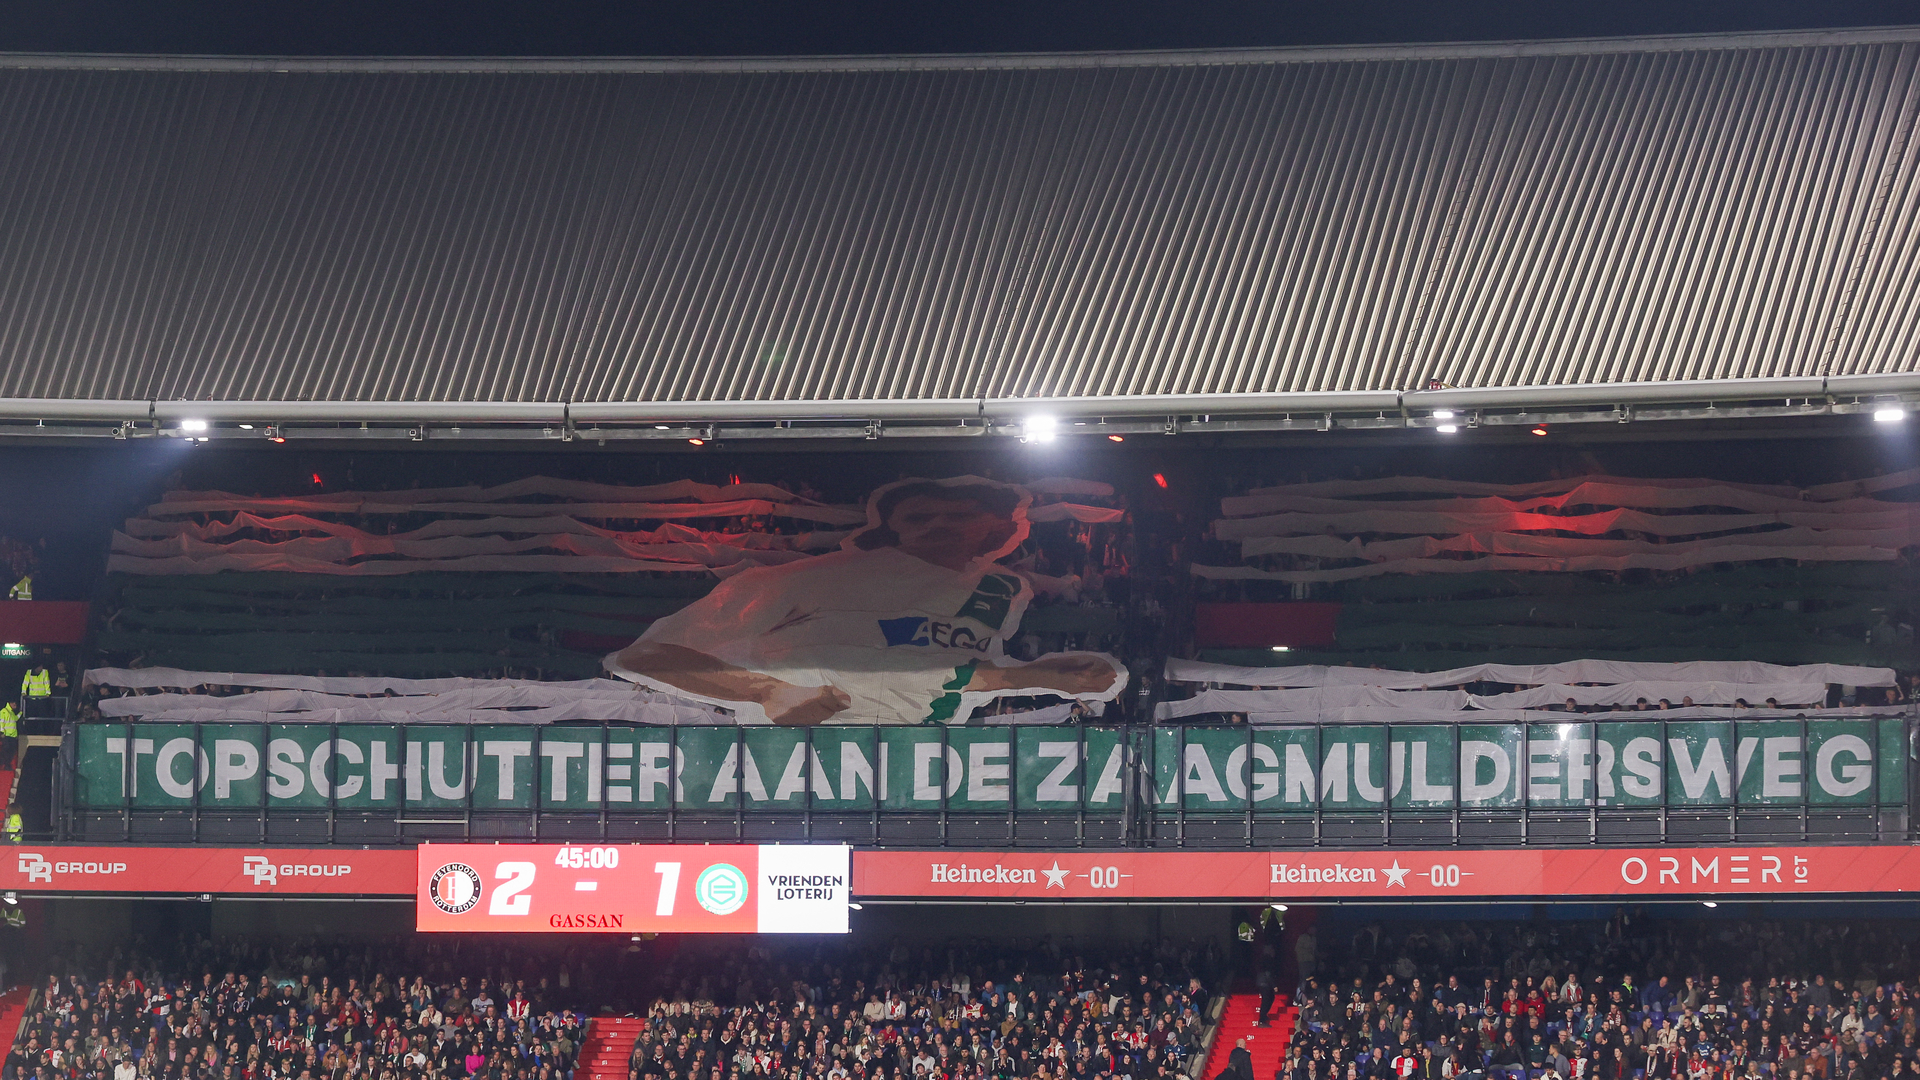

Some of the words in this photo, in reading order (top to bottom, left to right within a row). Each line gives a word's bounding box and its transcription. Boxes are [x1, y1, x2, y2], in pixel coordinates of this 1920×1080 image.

[106, 737, 684, 803] TOPSCHUTTER
[710, 741, 889, 802] AAN
[914, 741, 1010, 801] DE
[1037, 734, 1873, 805] ZAAGMULDERSWEG
[555, 847, 619, 869] 45:00
[54, 862, 127, 874] GROUP
[279, 864, 352, 877] GROUP
[433, 864, 478, 882] FEYENOORD
[931, 864, 1037, 883] Heineken
[1270, 864, 1377, 883] Heineken
[1621, 855, 1783, 885] ORMER
[1794, 855, 1808, 883] ICT
[489, 862, 536, 915] 2
[654, 862, 682, 916] 1
[768, 875, 843, 886] VRIENDEN
[777, 888, 833, 900] LOTERIJ
[433, 895, 478, 913] ROTTERDAM
[550, 914, 624, 928] GASSAN
